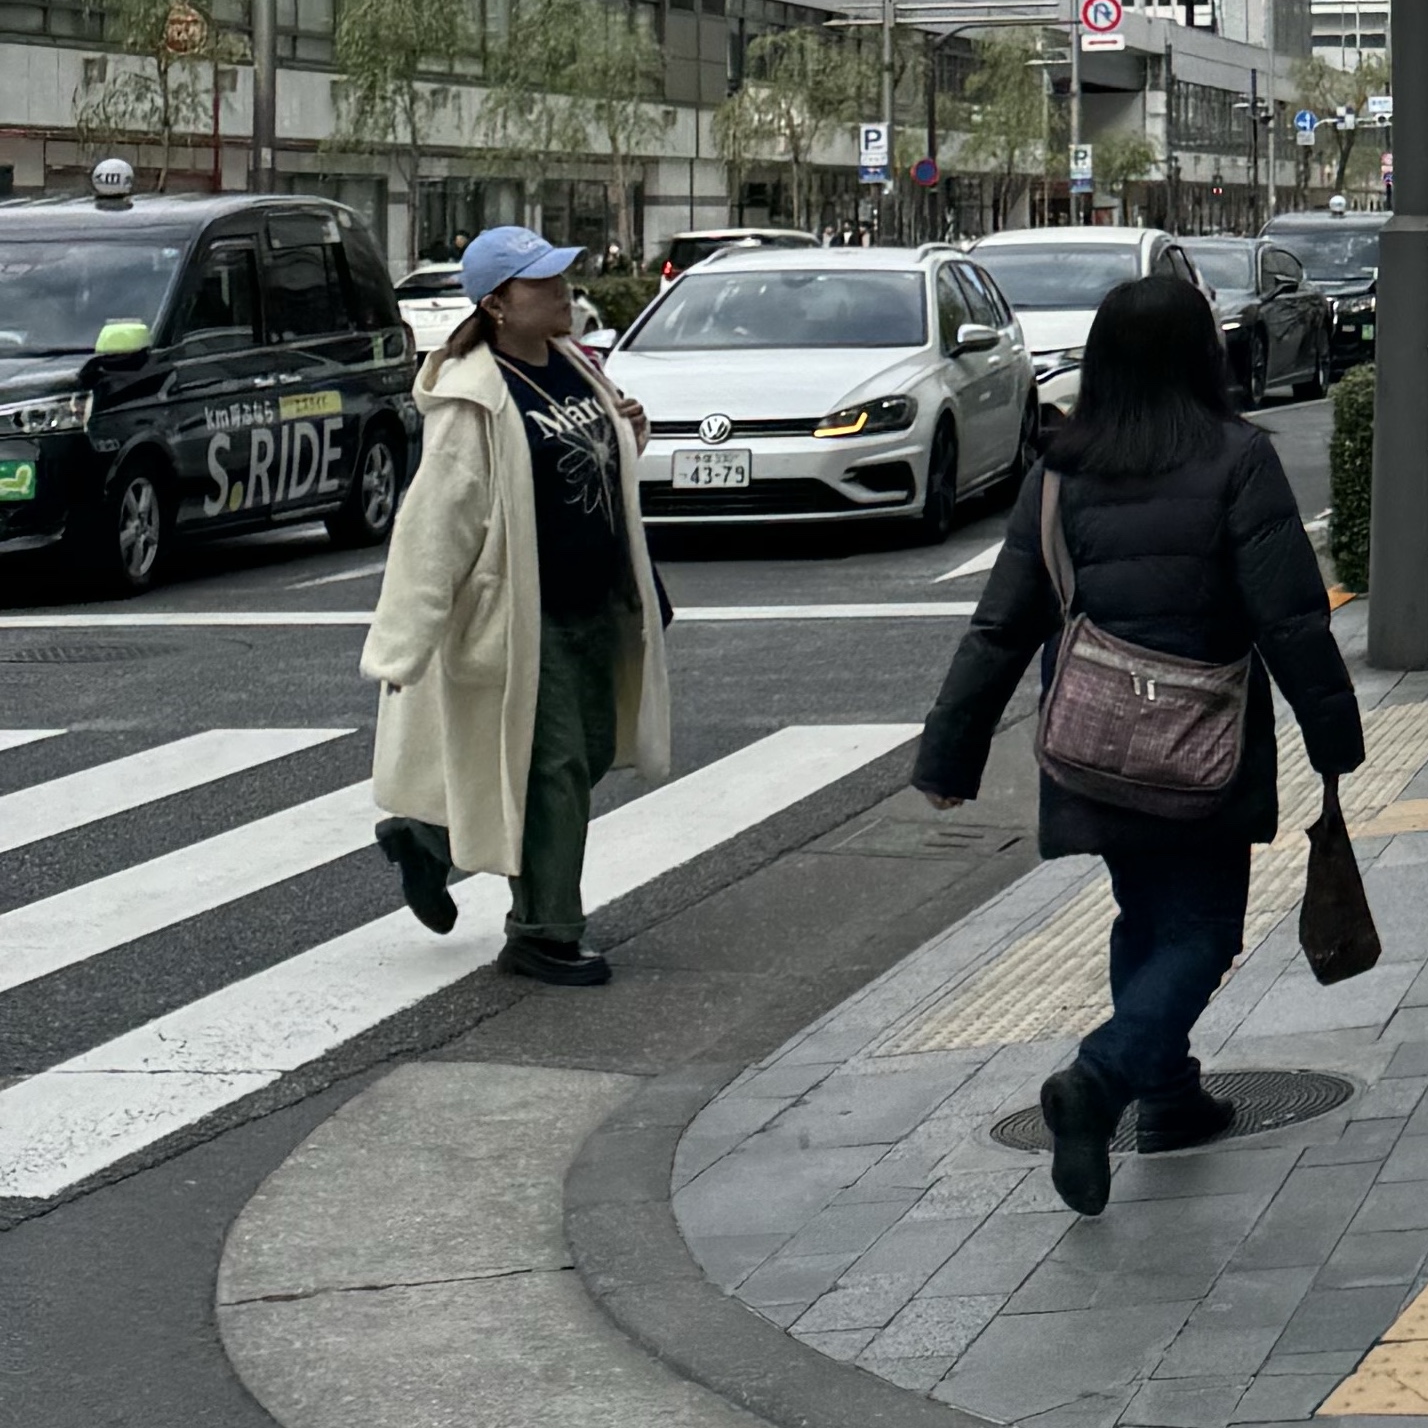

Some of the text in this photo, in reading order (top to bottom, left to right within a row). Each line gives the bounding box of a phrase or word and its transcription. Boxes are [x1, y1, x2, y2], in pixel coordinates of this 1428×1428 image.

[864, 129, 882, 151] P
[1074, 149, 1088, 166] P
[203, 416, 344, 517] S.RIDE
[690, 465, 745, 485] 43-79
